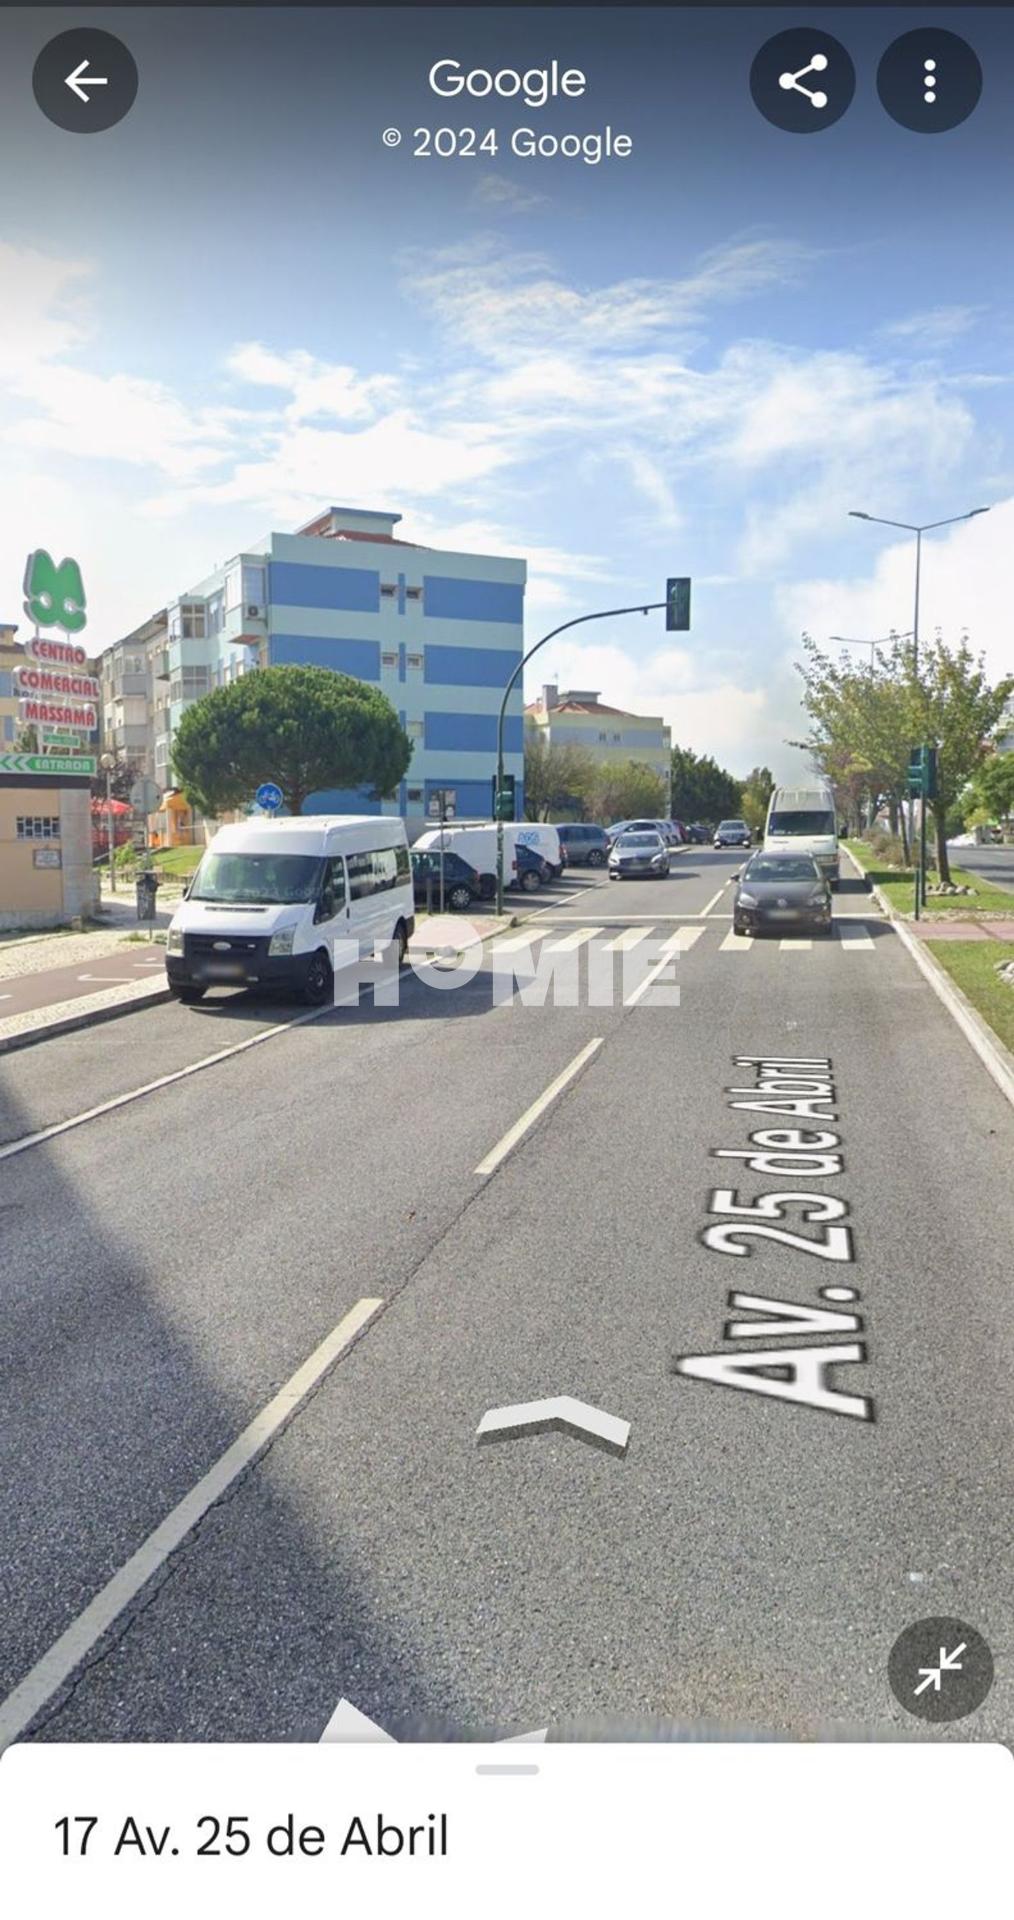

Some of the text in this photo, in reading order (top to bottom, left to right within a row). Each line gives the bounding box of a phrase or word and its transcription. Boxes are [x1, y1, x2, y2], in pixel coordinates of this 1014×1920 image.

[32, 639, 85, 664] CENTRO
[19, 671, 99, 697] COMERCIAL
[35, 758, 90, 771] ENTRADA
